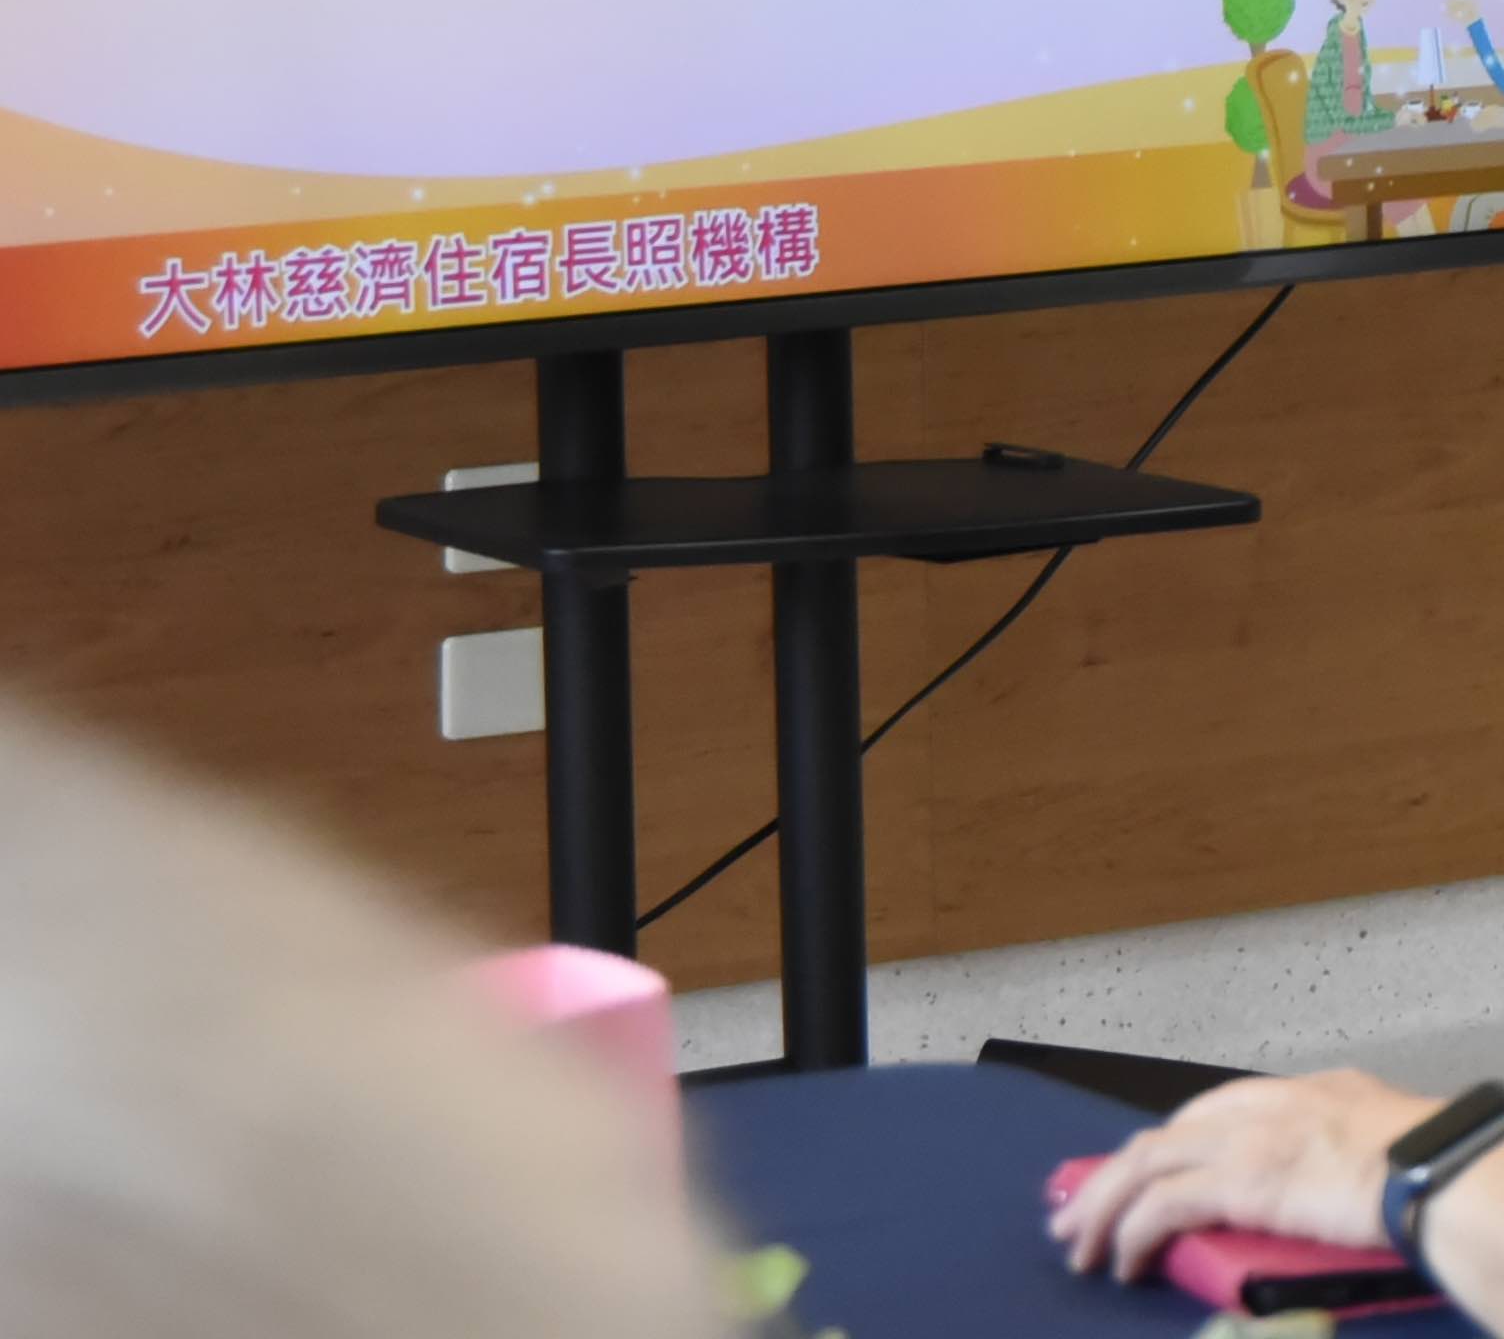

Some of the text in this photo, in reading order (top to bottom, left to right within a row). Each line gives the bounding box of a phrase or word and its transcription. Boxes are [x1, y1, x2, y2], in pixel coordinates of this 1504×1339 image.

[139, 204, 820, 335] 大林慈濟住宿長照機構
